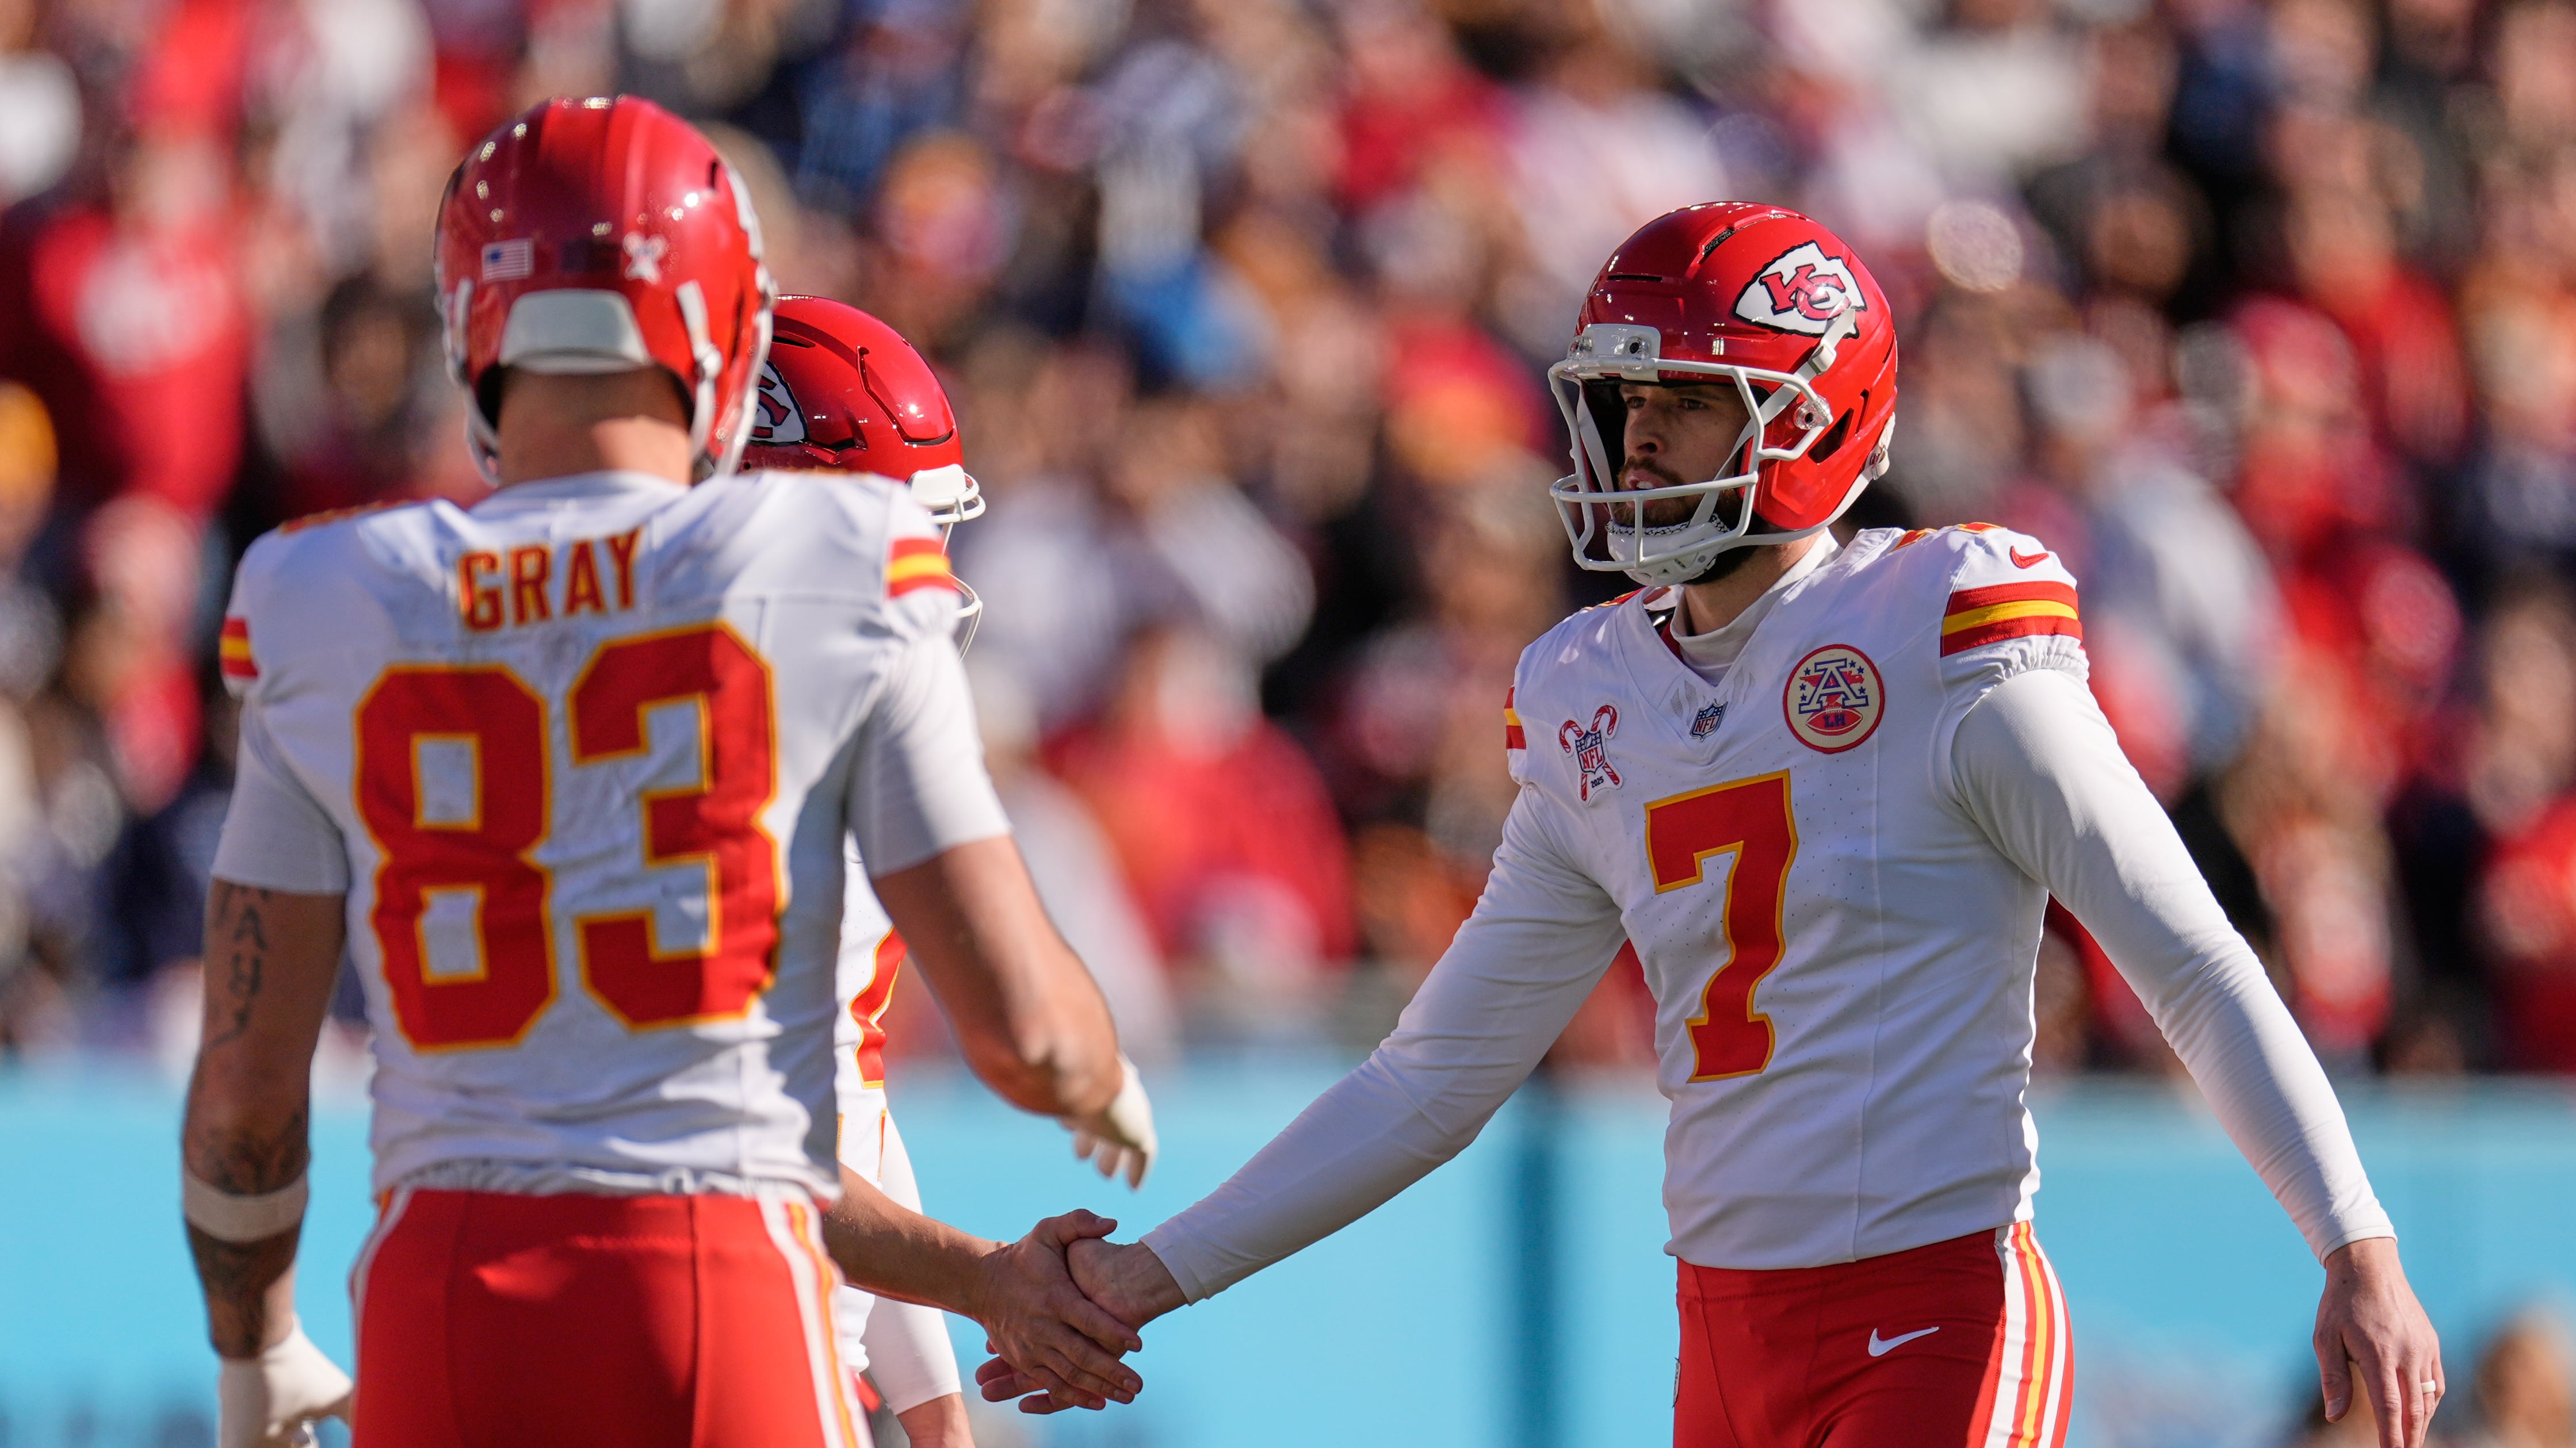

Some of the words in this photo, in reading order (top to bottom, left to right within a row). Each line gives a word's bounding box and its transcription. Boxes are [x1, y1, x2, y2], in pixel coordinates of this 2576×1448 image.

[1759, 263, 1852, 321] KC
[458, 526, 643, 633] GRAY
[1799, 658, 1868, 714] A
[1694, 717, 1715, 733] NFL
[1824, 713, 1845, 727] LH
[1580, 747, 1603, 769] NFL
[1591, 776, 1604, 788] 2025
[354, 619, 783, 1055] 83
[1644, 768, 1798, 1083] 7
